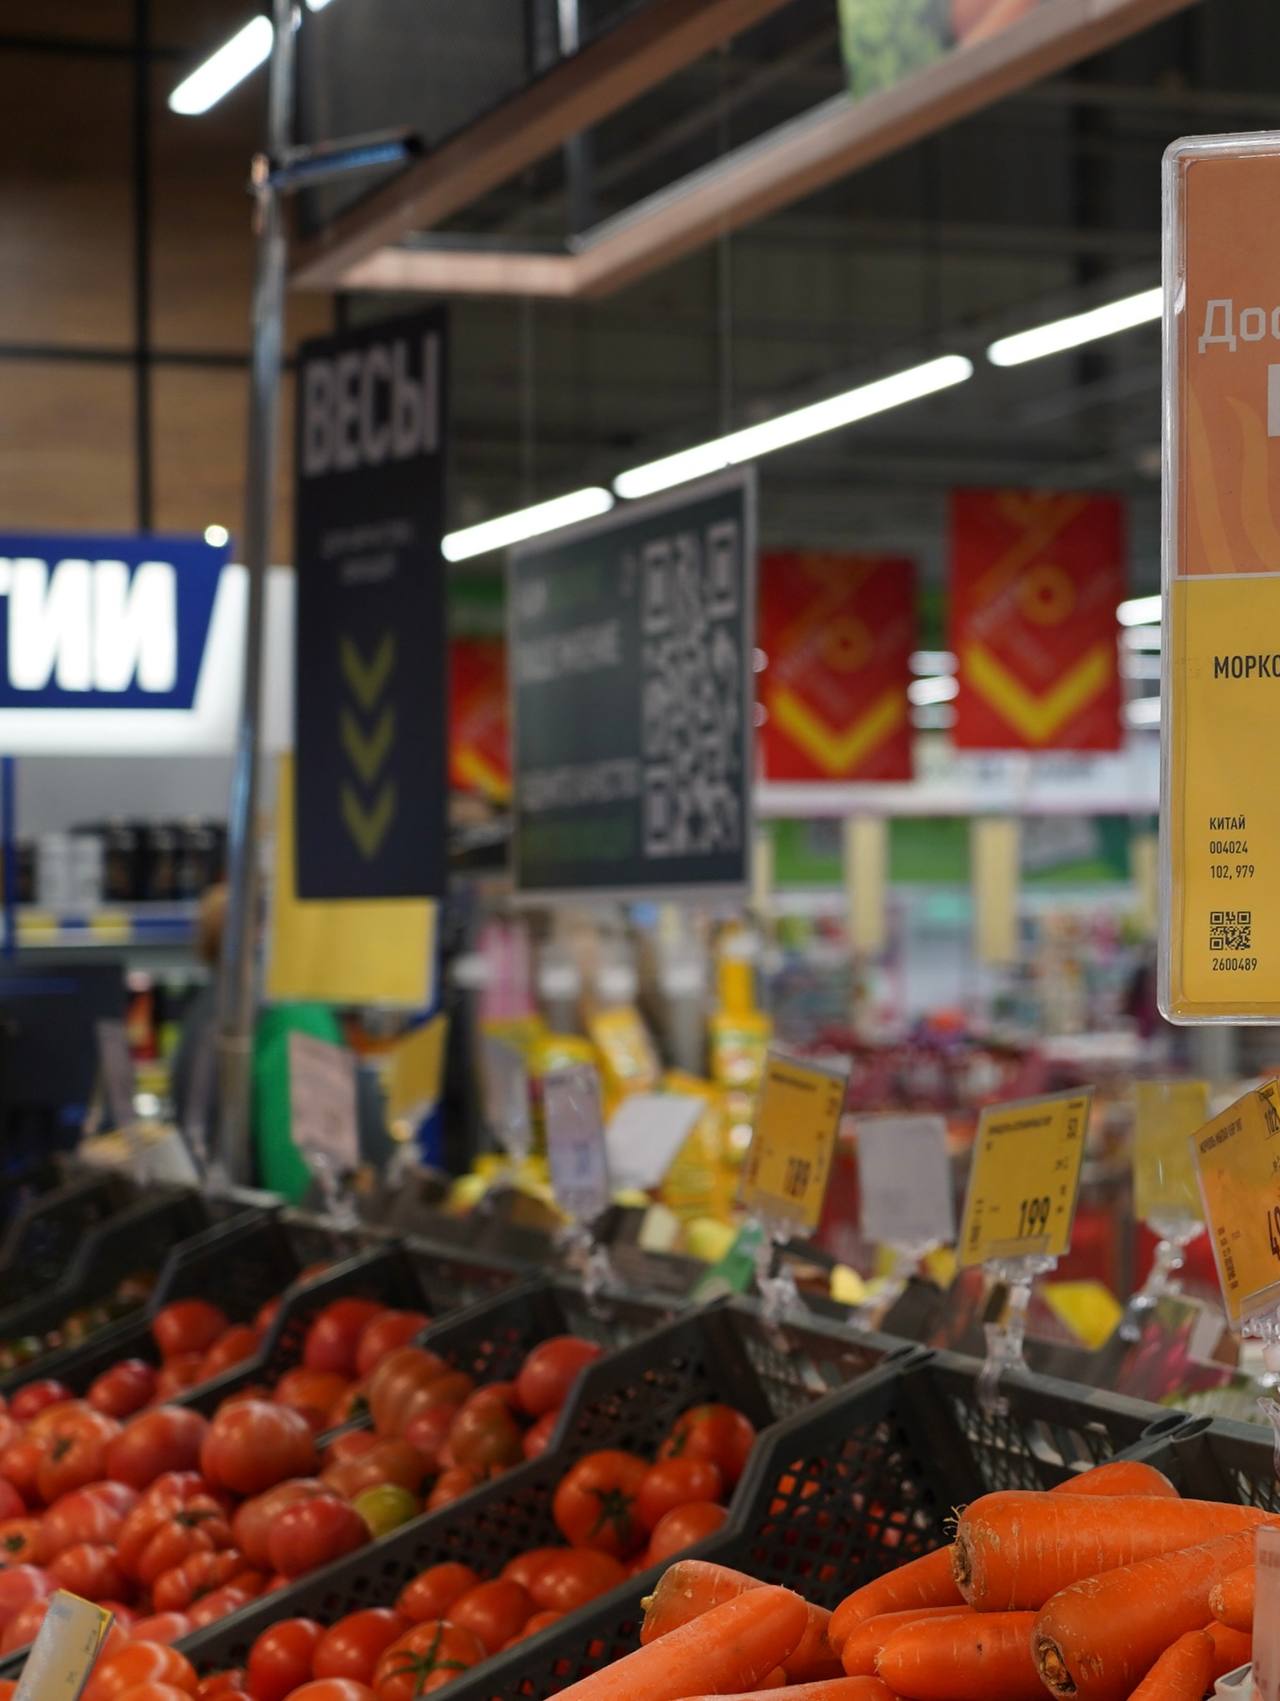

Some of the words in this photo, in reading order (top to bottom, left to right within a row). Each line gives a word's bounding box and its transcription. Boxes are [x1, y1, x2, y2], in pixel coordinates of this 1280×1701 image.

[303, 332, 438, 477] ВЕСЫ
[0, 557, 177, 693] ИИ
[1209, 814, 1246, 831] КИТАЙ
[1209, 840, 1249, 855] 004024
[1212, 957, 1258, 972] 2600489
[1019, 1196, 1050, 1236] 199
